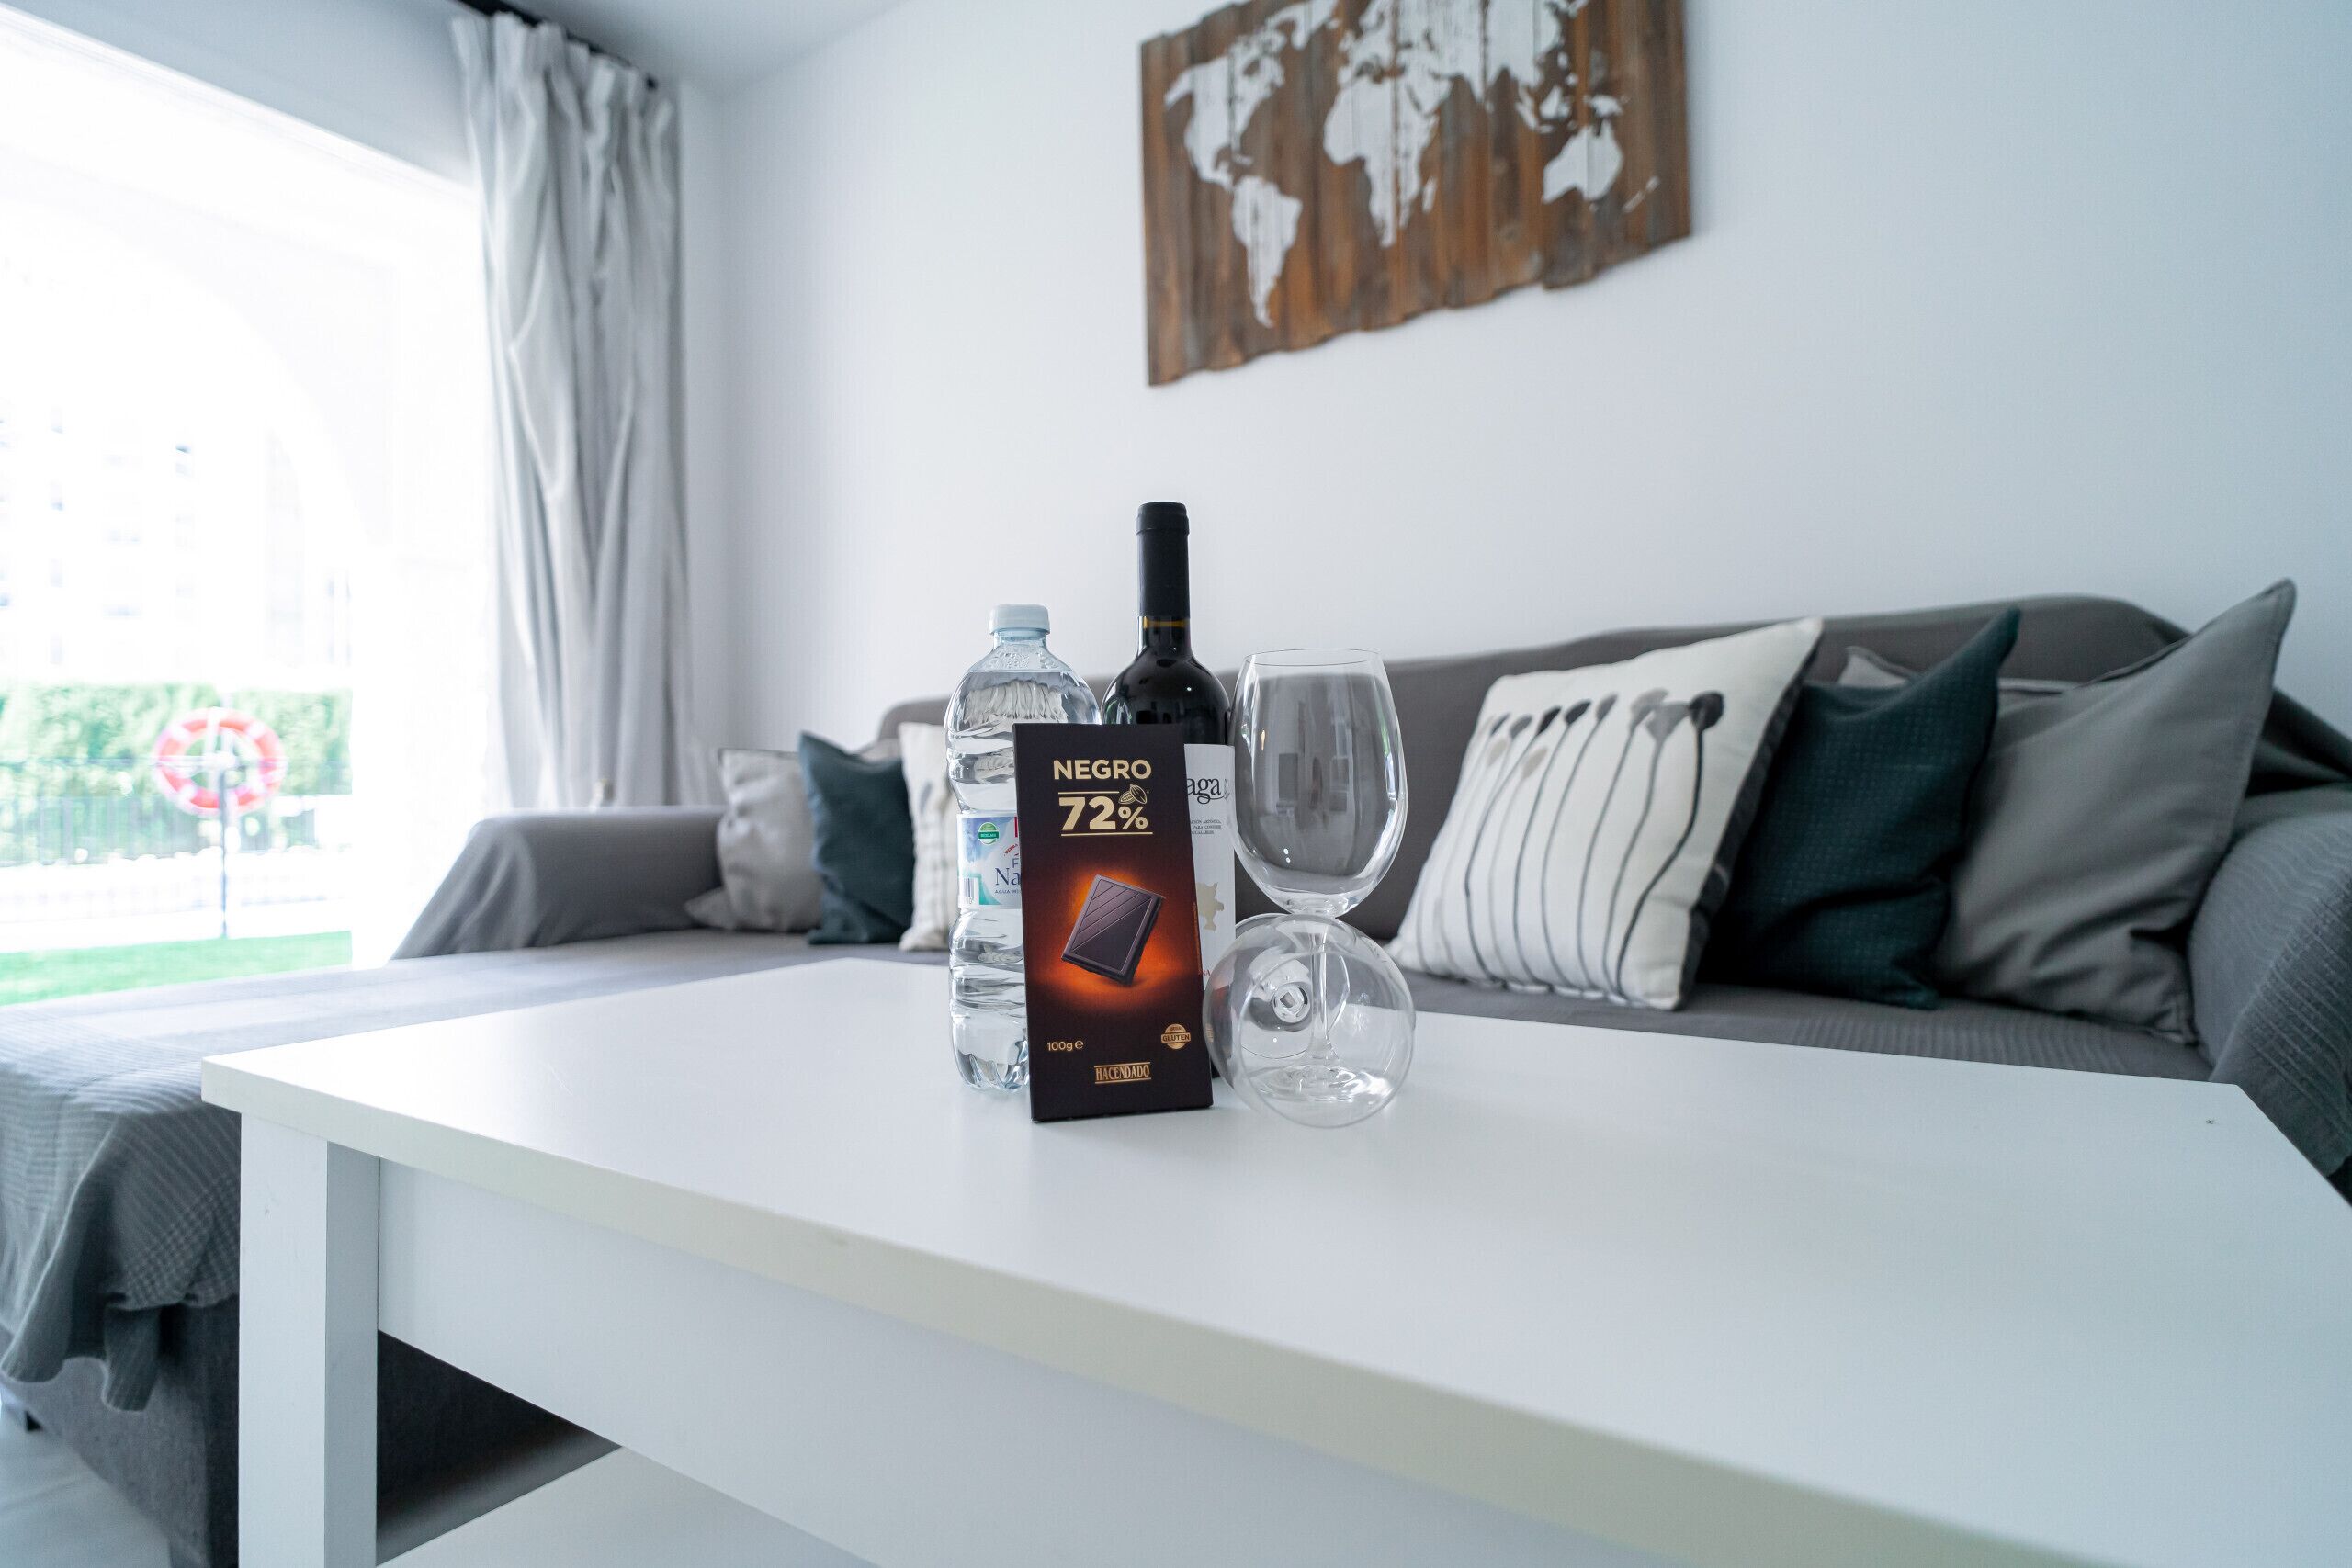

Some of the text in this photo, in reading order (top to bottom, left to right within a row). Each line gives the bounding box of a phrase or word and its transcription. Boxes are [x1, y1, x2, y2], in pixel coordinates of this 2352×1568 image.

[1053, 759, 1152, 780] NEGRO
[1058, 795, 1148, 831] 72%
[1046, 1041, 1073, 1052] 100g
[1095, 1064, 1149, 1081] HACENDADO
